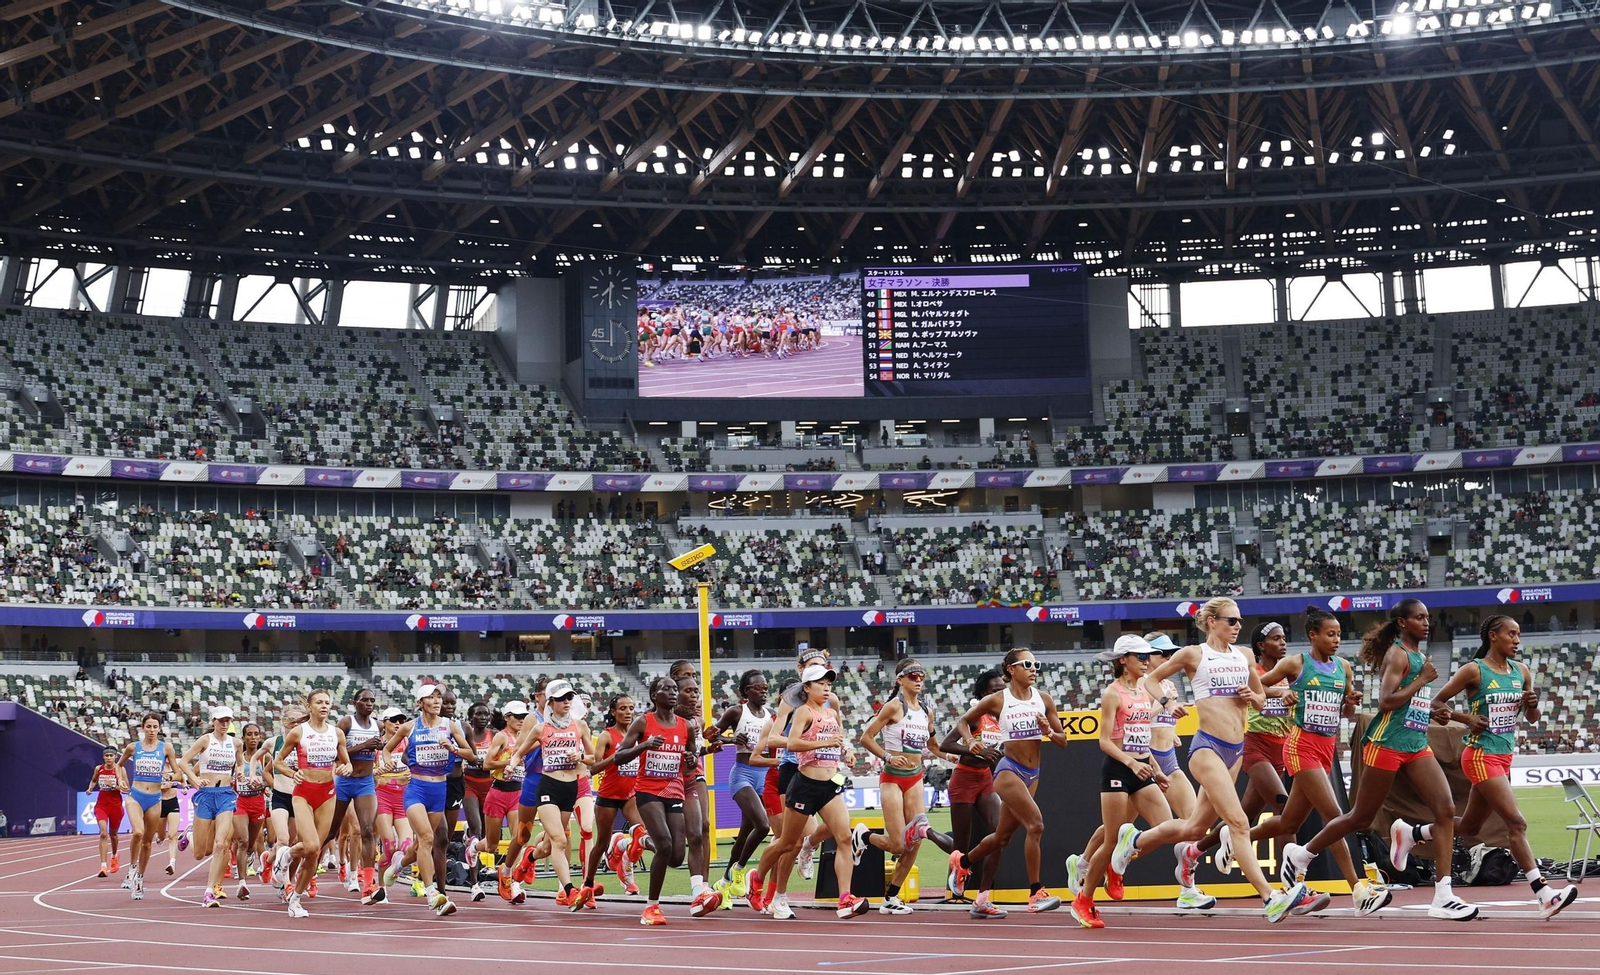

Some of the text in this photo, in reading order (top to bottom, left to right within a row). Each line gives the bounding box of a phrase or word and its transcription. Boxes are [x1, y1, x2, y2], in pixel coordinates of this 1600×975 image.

[868, 278, 922, 288] 女子マラソン
[932, 278, 950, 287] 決勝
[592, 328, 604, 338] 45
[681, 552, 704, 567] SEIKO
[1211, 676, 1247, 687] SULLIVAN
[1485, 693, 1523, 704] ETHIOP
[1408, 711, 1430, 723] ASSE
[1492, 715, 1517, 726] KEBED
[1012, 720, 1037, 730] KEM
[545, 740, 576, 748] JAPAN
[647, 761, 678, 771] CHUMBA
[1526, 768, 1600, 783] SONY
